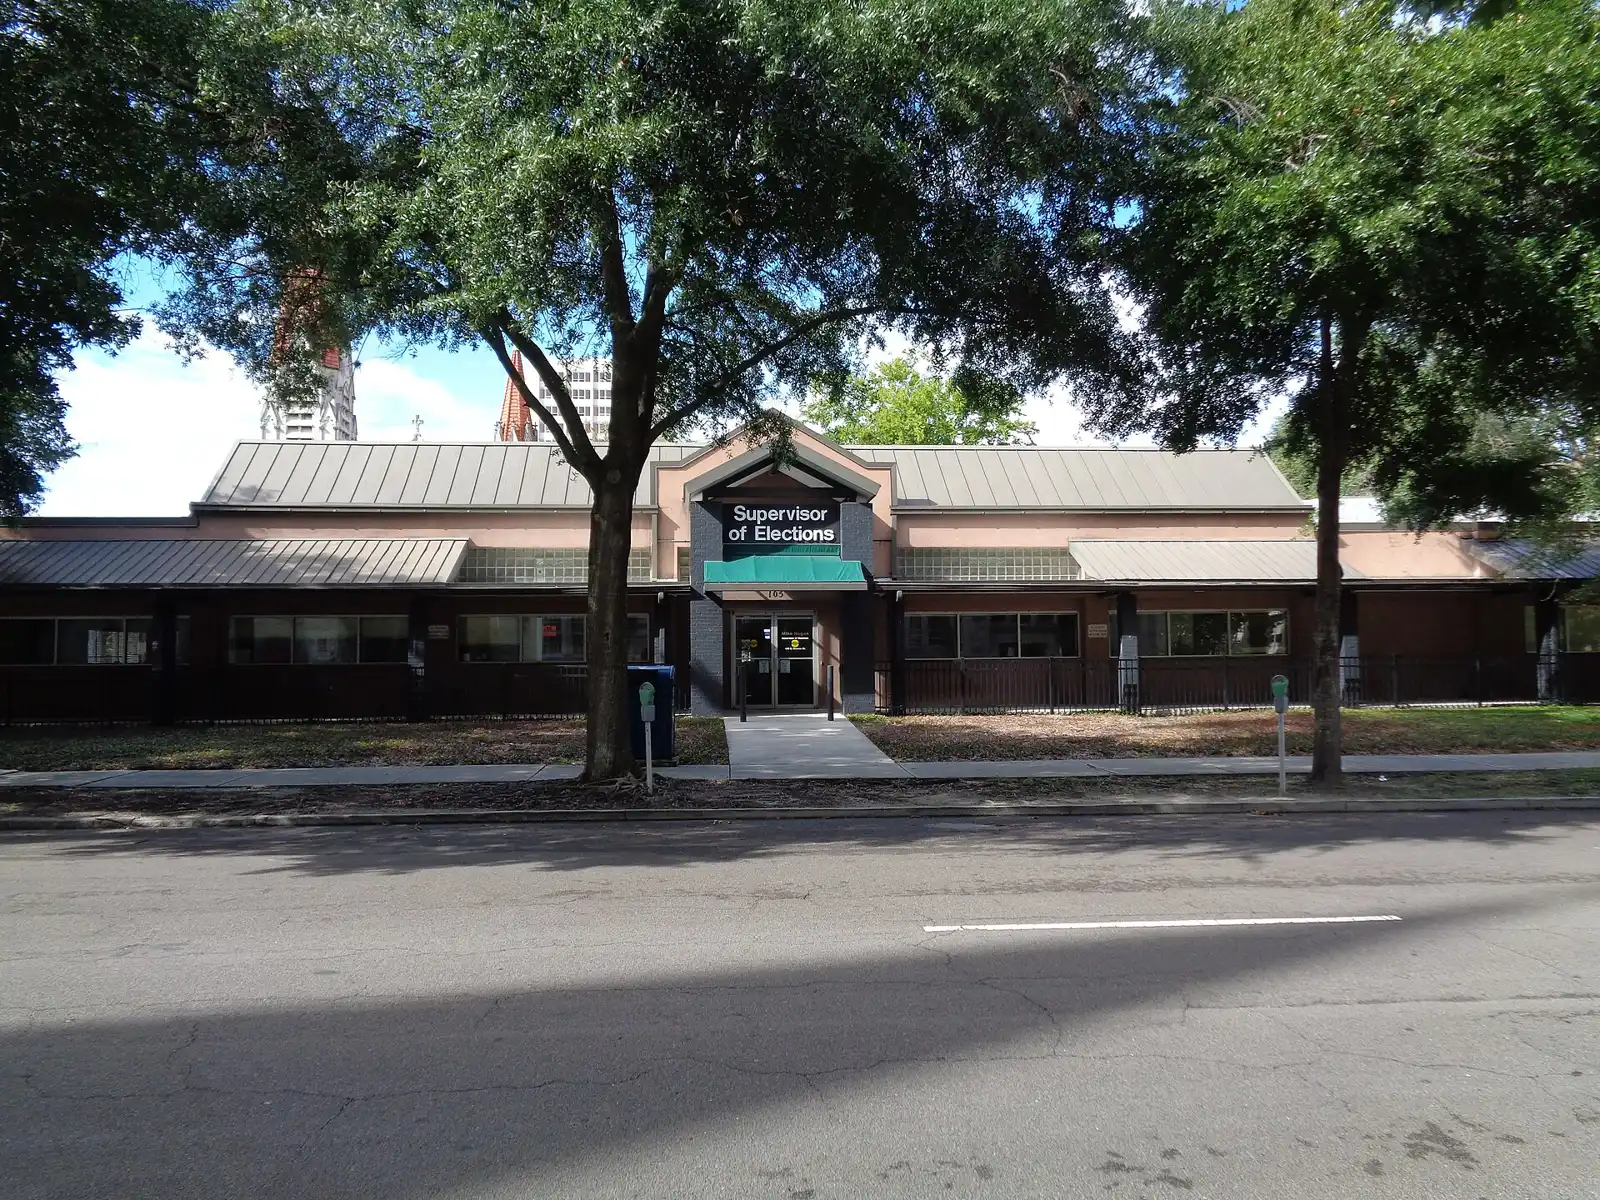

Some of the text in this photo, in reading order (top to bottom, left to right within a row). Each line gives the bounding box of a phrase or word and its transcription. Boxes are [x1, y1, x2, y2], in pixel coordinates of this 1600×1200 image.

[733, 505, 828, 524] Supervisor
[728, 526, 835, 541] of Elections
[768, 590, 784, 598] 105
